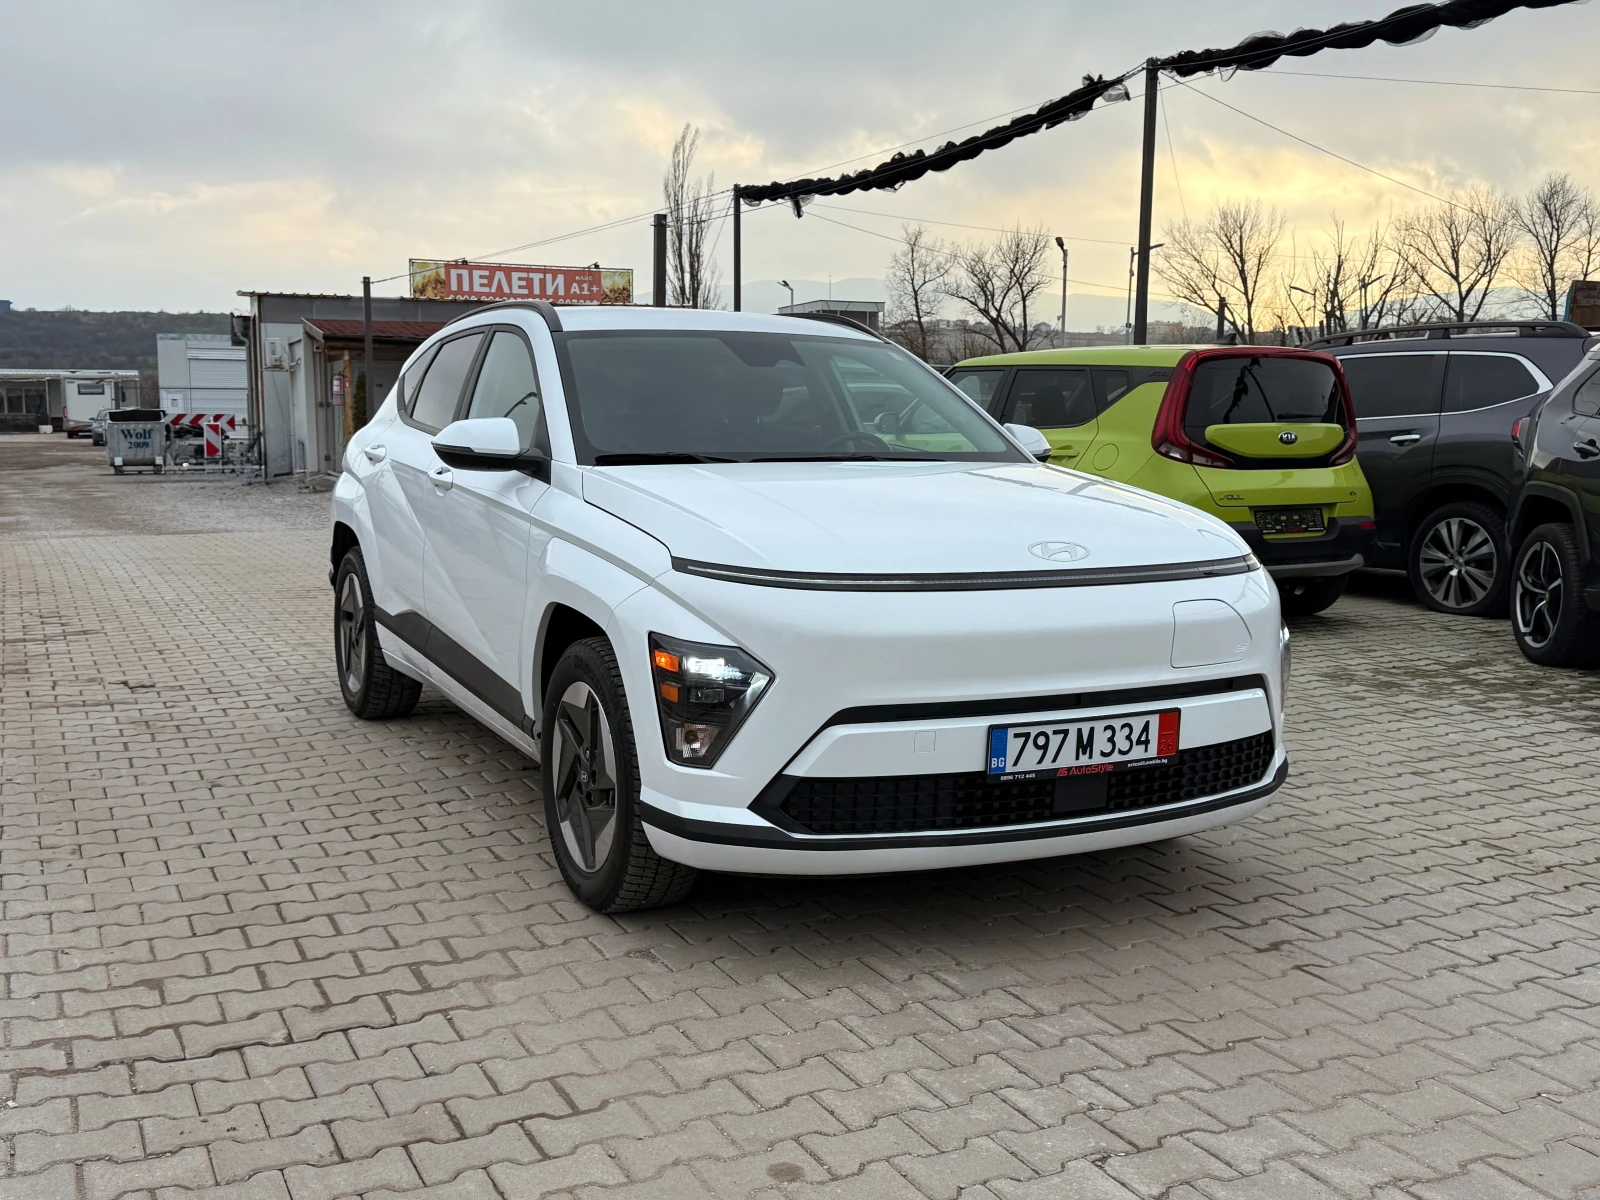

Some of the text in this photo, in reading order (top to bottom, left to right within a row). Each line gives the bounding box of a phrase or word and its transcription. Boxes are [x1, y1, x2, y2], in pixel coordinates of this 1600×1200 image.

[449, 268, 565, 296] ПЕЛЕТИ
[120, 429, 153, 440] Wolf
[1282, 432, 1297, 443] KIA
[128, 441, 149, 450] 2009
[1011, 720, 1151, 767] 797 M 334
[991, 757, 1005, 768] BG
[1069, 763, 1114, 776] AutoStyle
